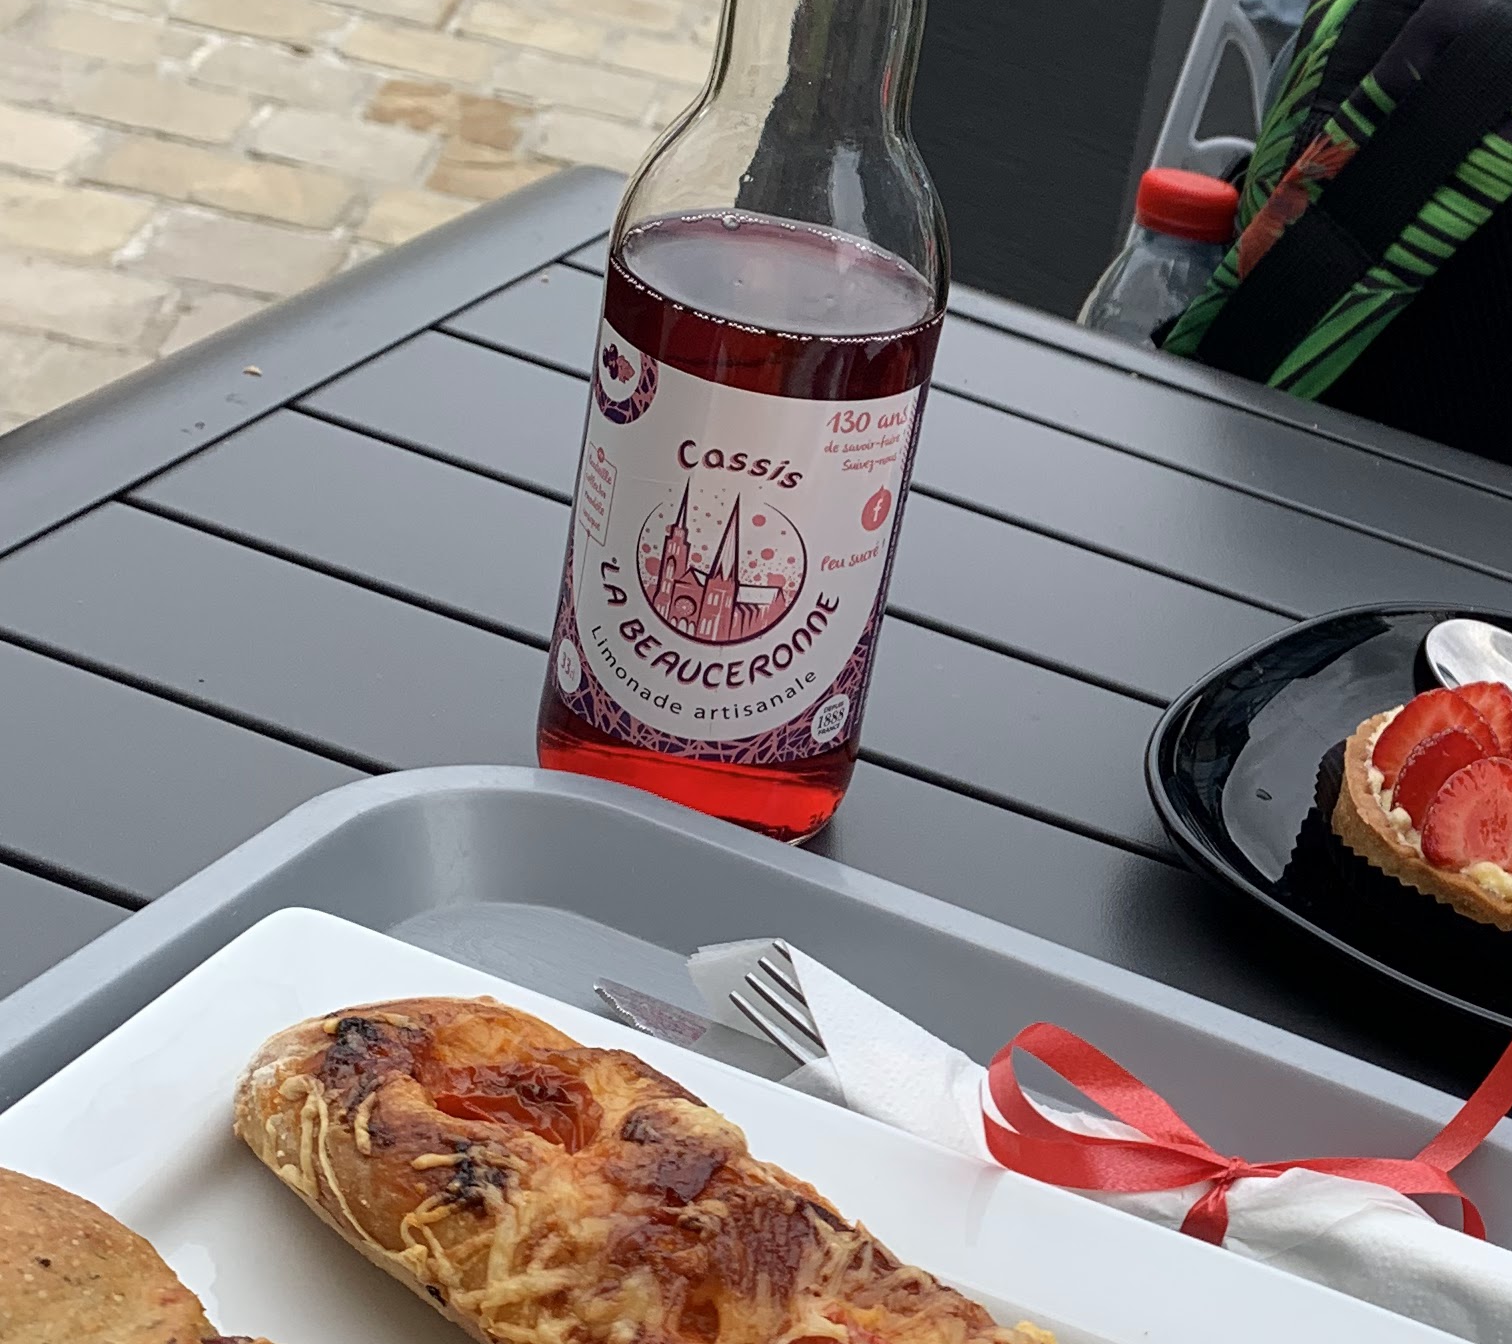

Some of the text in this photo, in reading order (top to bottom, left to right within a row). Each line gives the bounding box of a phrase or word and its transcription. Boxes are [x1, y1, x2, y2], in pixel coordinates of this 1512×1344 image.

[826, 405, 908, 433] 130 ans
[824, 440, 840, 453] de
[677, 439, 803, 488] Cassis
[820, 555, 845, 571] Peu
[601, 560, 840, 690] LA BEAUCERONNE
[592, 625, 817, 720] Limonade artisanale
[817, 707, 845, 729] 1888
